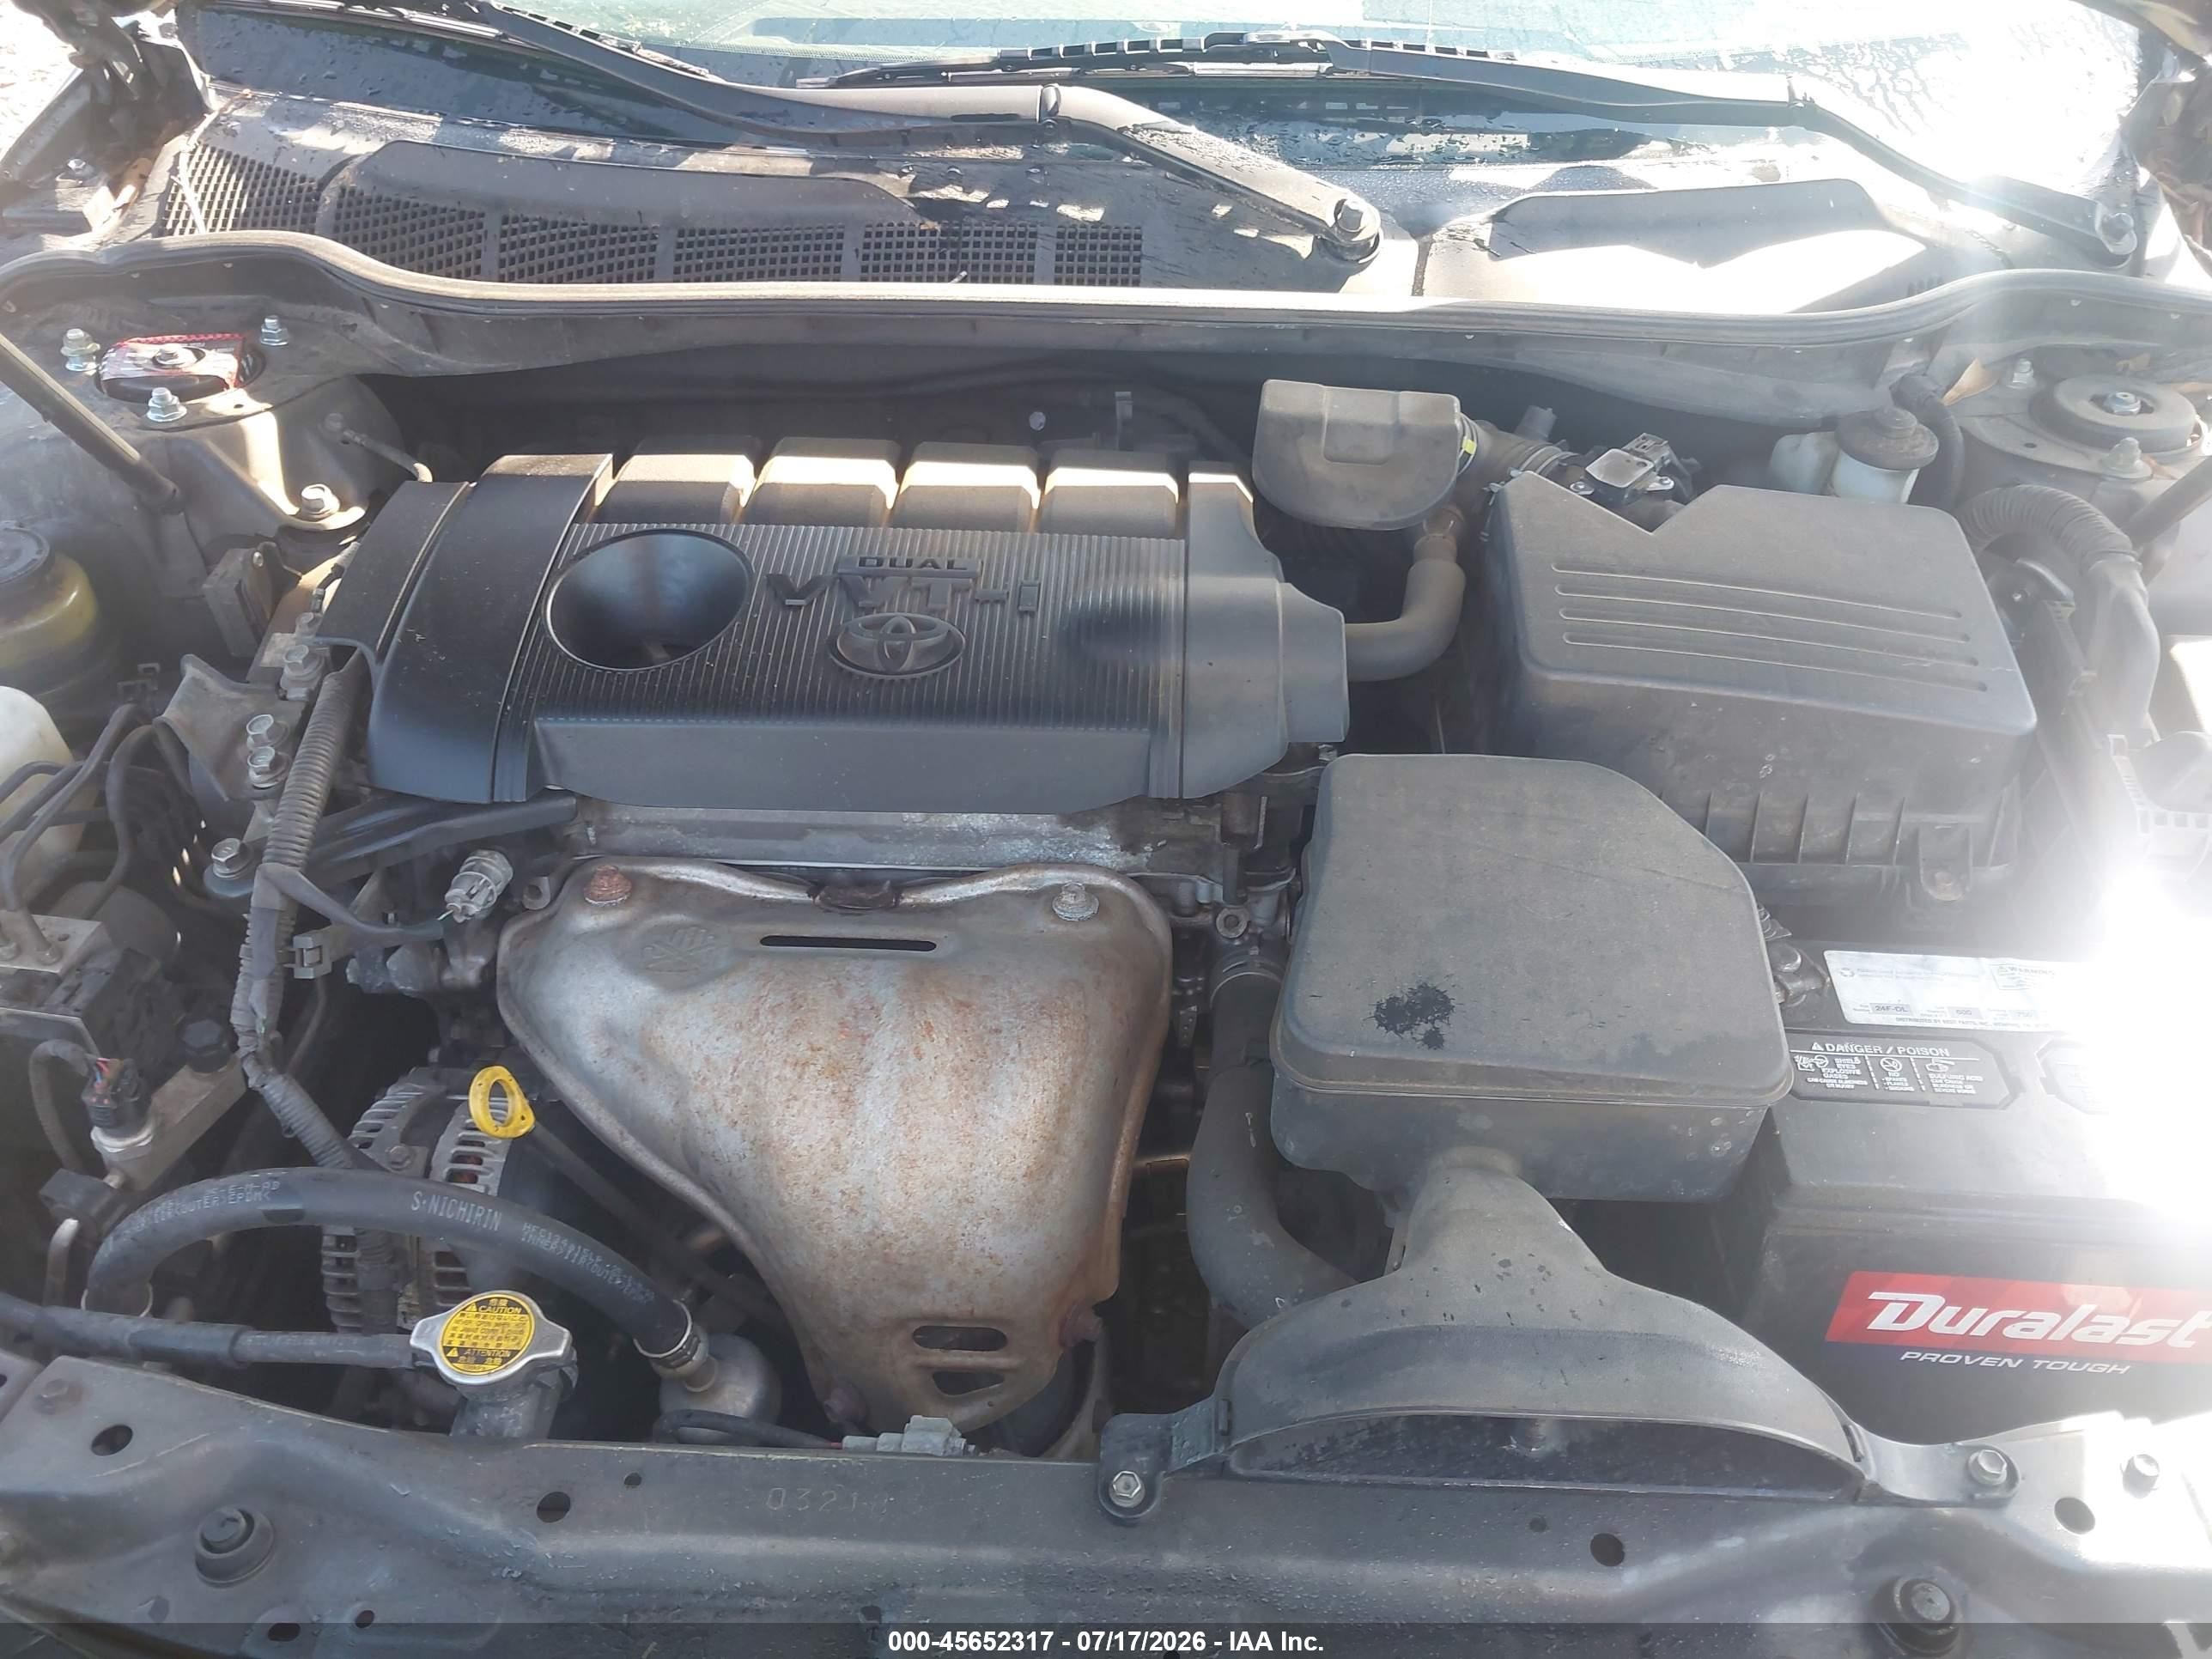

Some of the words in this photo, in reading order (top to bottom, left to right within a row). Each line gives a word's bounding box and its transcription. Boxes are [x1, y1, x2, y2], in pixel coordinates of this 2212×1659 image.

[859, 556, 969, 570] DUAL
[1825, 1043, 1882, 1054] DANGER
[1896, 1046, 1950, 1056] POISON
[478, 1305, 522, 1315] CAUTION
[1867, 1291, 2212, 1348] Duralast
[464, 1348, 511, 1358] ATTENTION
[1899, 1351, 2025, 1369] PROVEN
[2033, 1359, 2131, 1375] TOUGH
